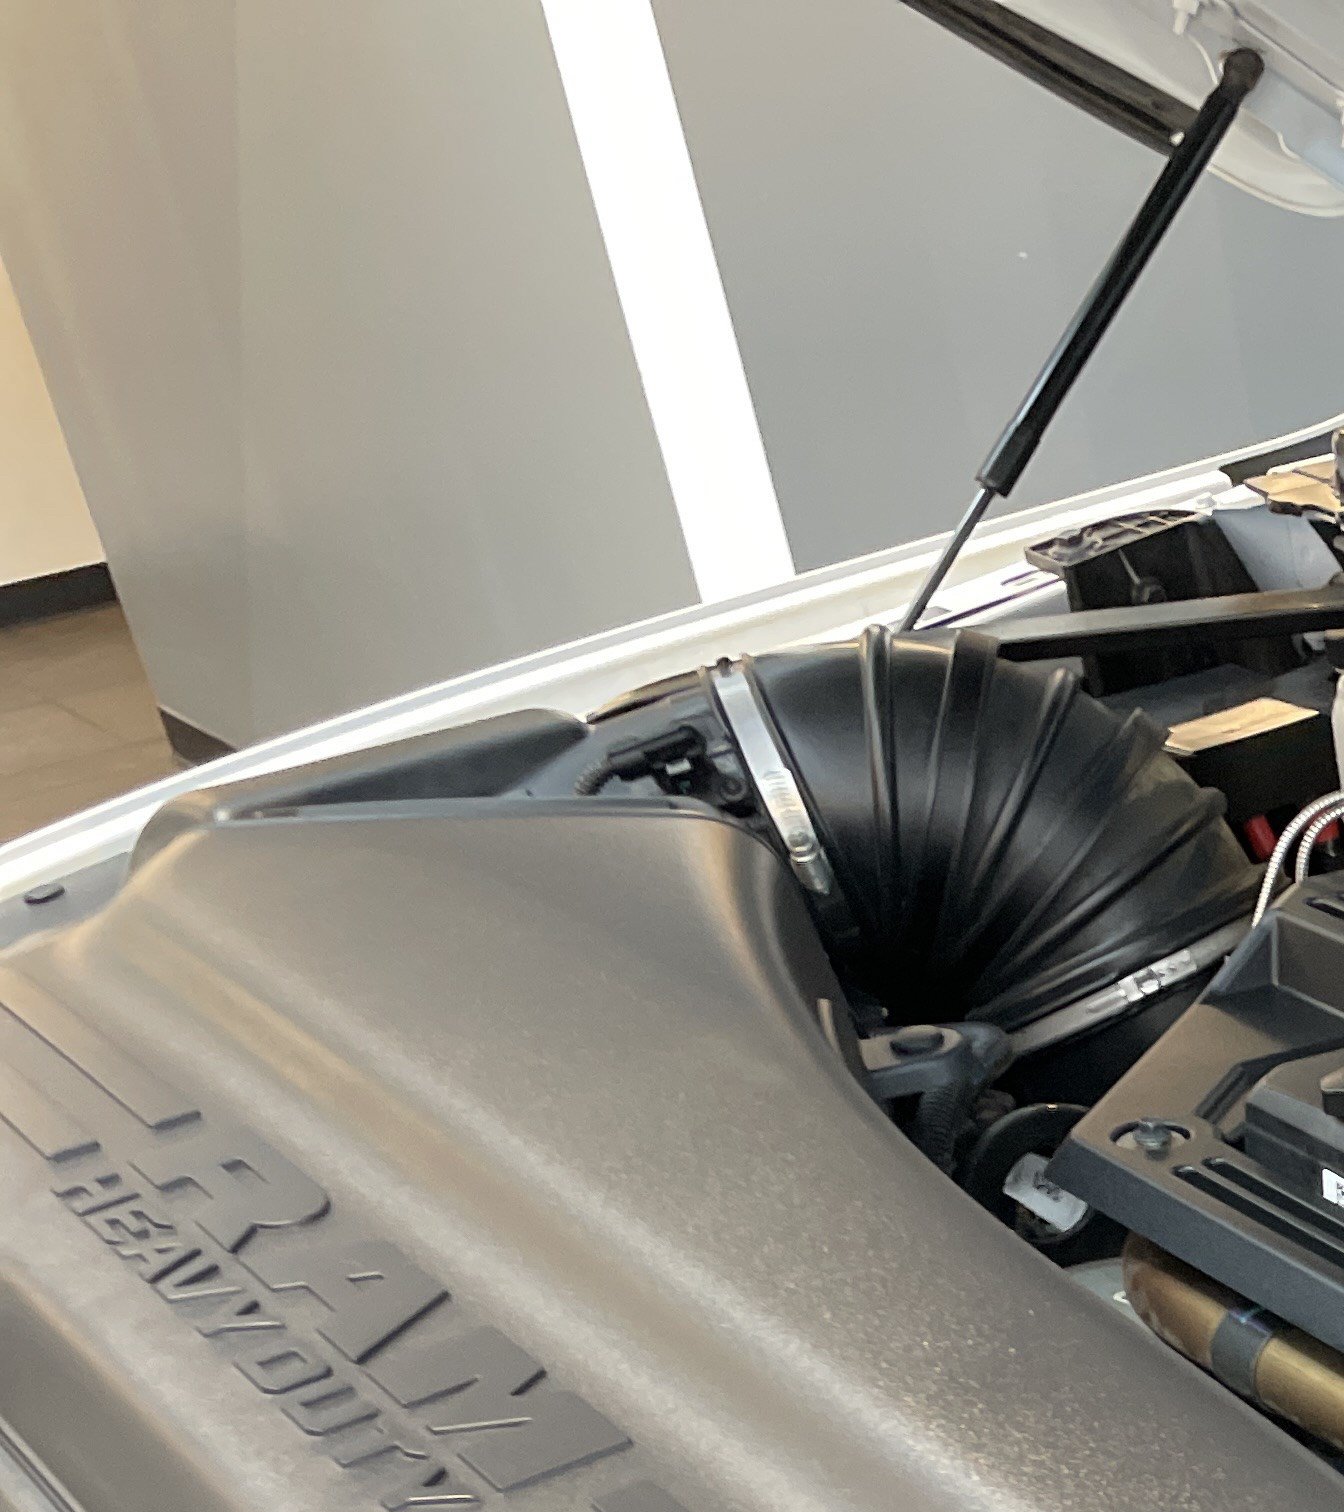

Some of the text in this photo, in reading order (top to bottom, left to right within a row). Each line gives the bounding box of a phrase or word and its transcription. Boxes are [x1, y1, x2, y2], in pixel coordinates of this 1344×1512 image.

[52, 1165, 487, 1512] HEAVY DUTY
[130, 1110, 635, 1494] RAM
